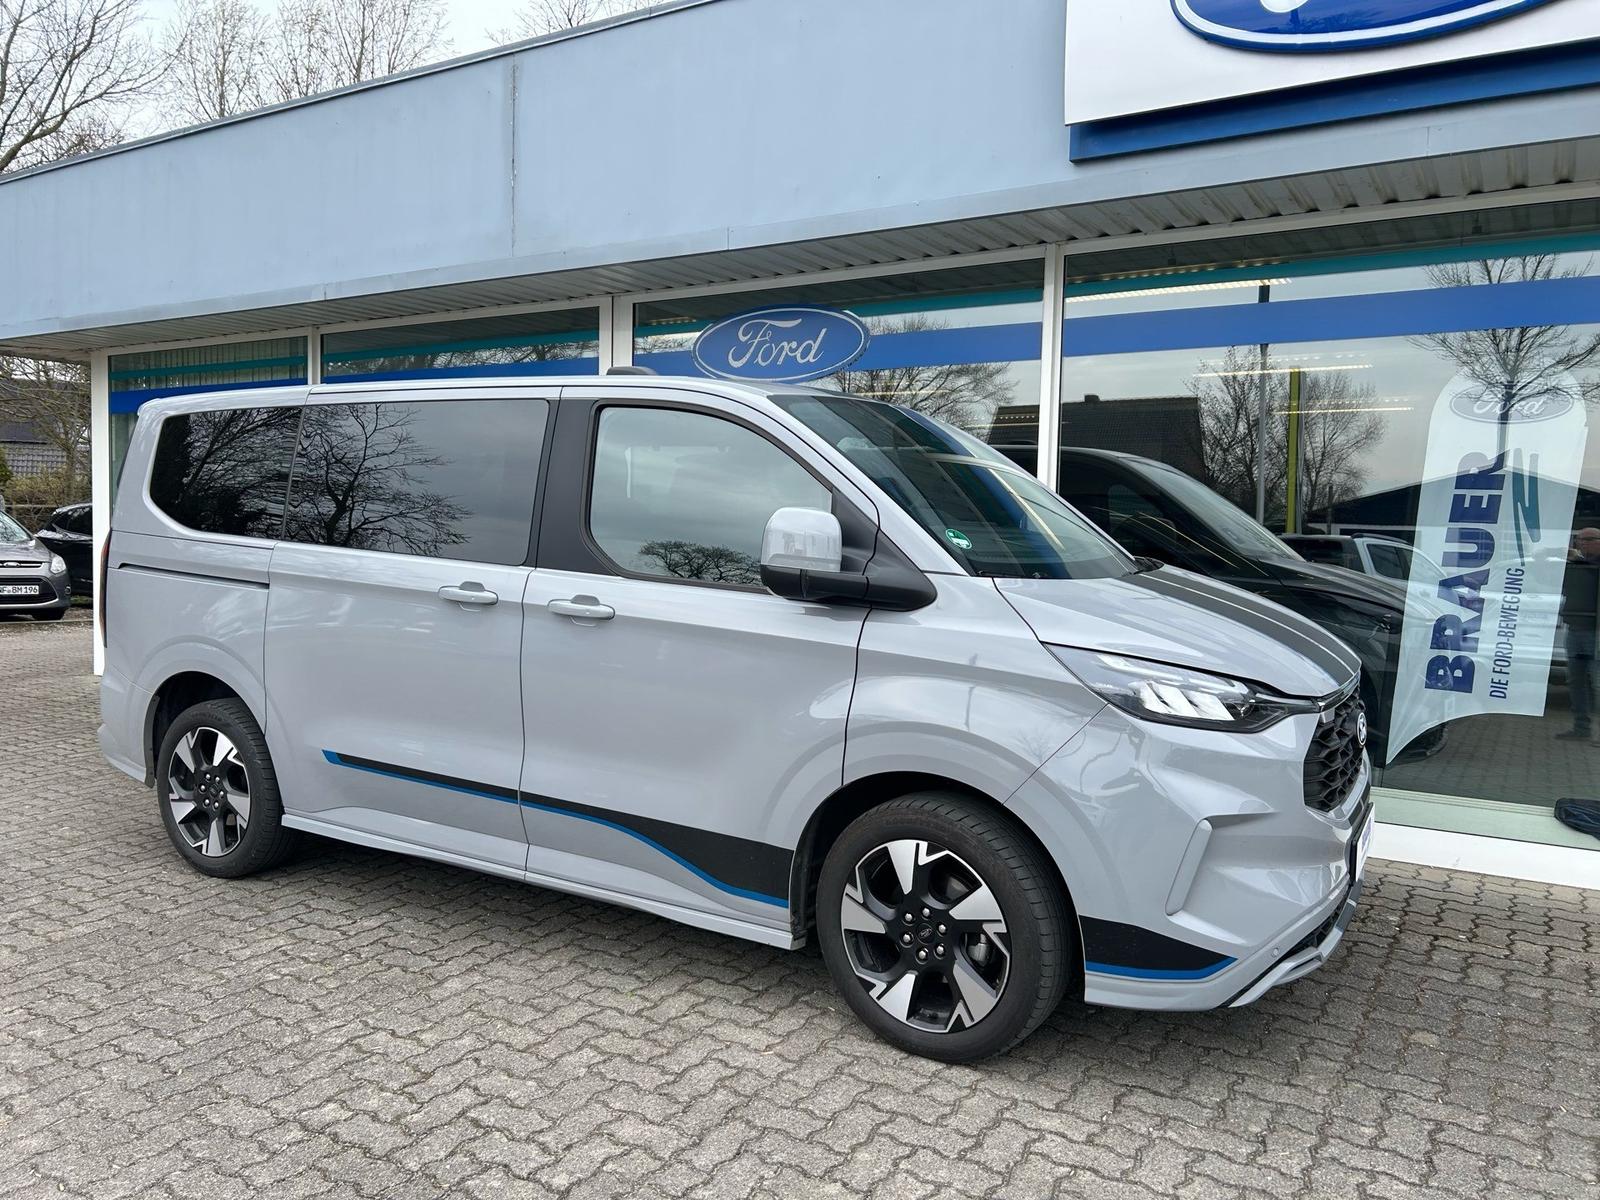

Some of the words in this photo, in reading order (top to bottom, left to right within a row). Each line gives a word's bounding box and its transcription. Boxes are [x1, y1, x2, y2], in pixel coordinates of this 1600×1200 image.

[728, 318, 827, 368] Ford
[1424, 451, 1506, 694] BRAUER
[1492, 567, 1525, 675] FORD-BEWEGUNG
[1489, 678, 1509, 700] DIE
